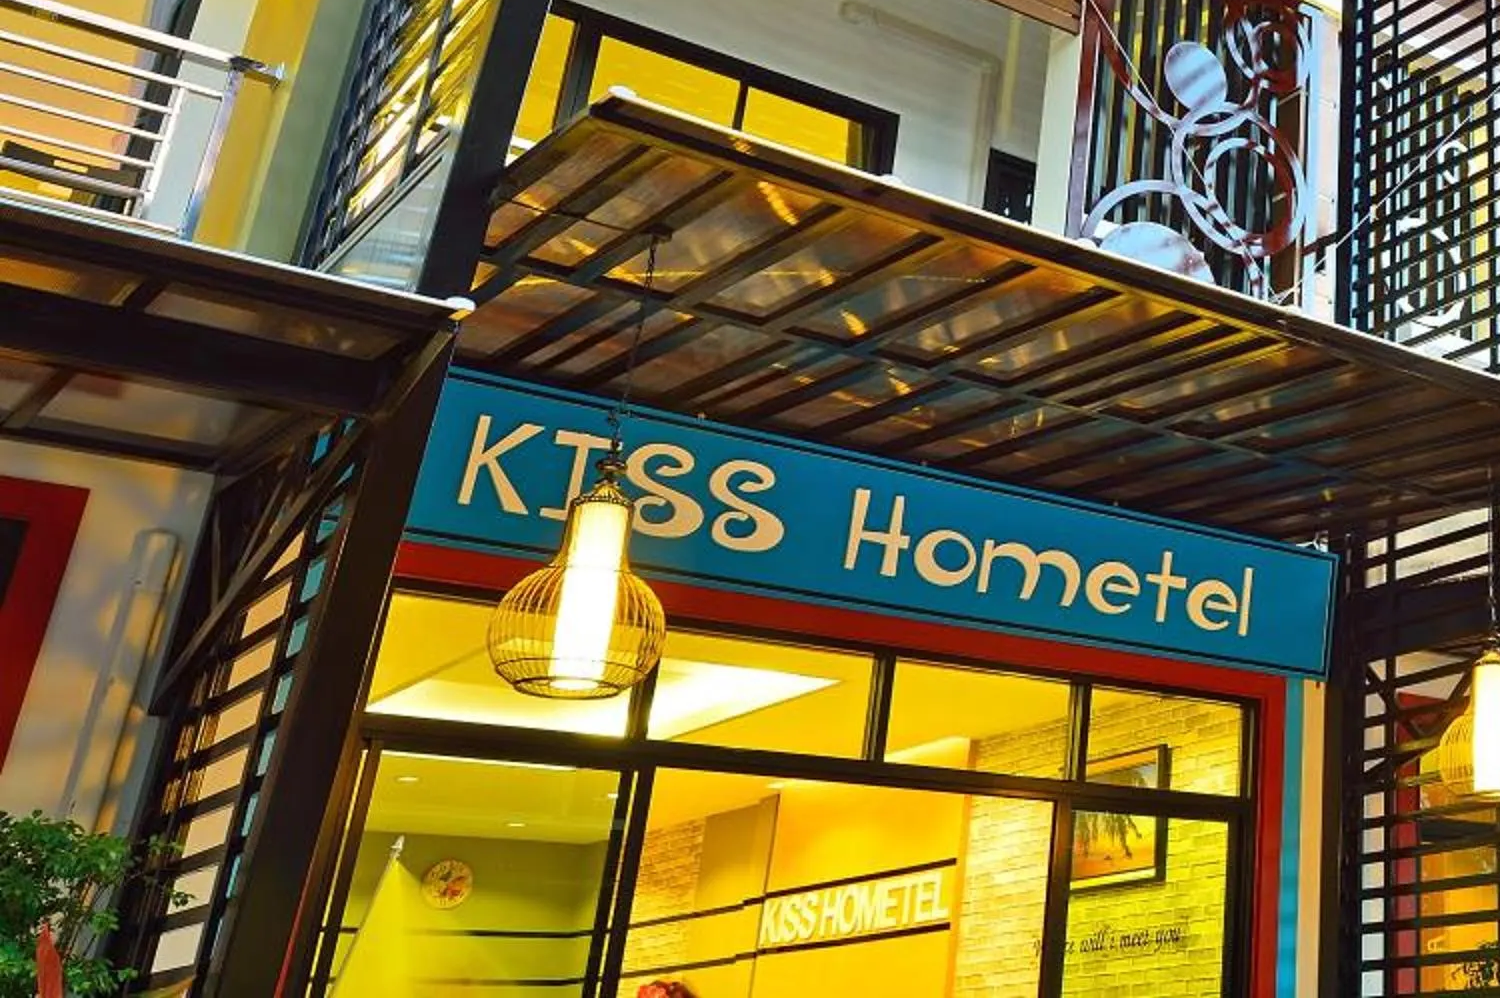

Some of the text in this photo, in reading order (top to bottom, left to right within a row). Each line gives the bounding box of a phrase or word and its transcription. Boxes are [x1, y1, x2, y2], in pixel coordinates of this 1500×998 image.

[457, 414, 1254, 637] KISS Hometel
[759, 870, 949, 946] KISS HOMETEL
